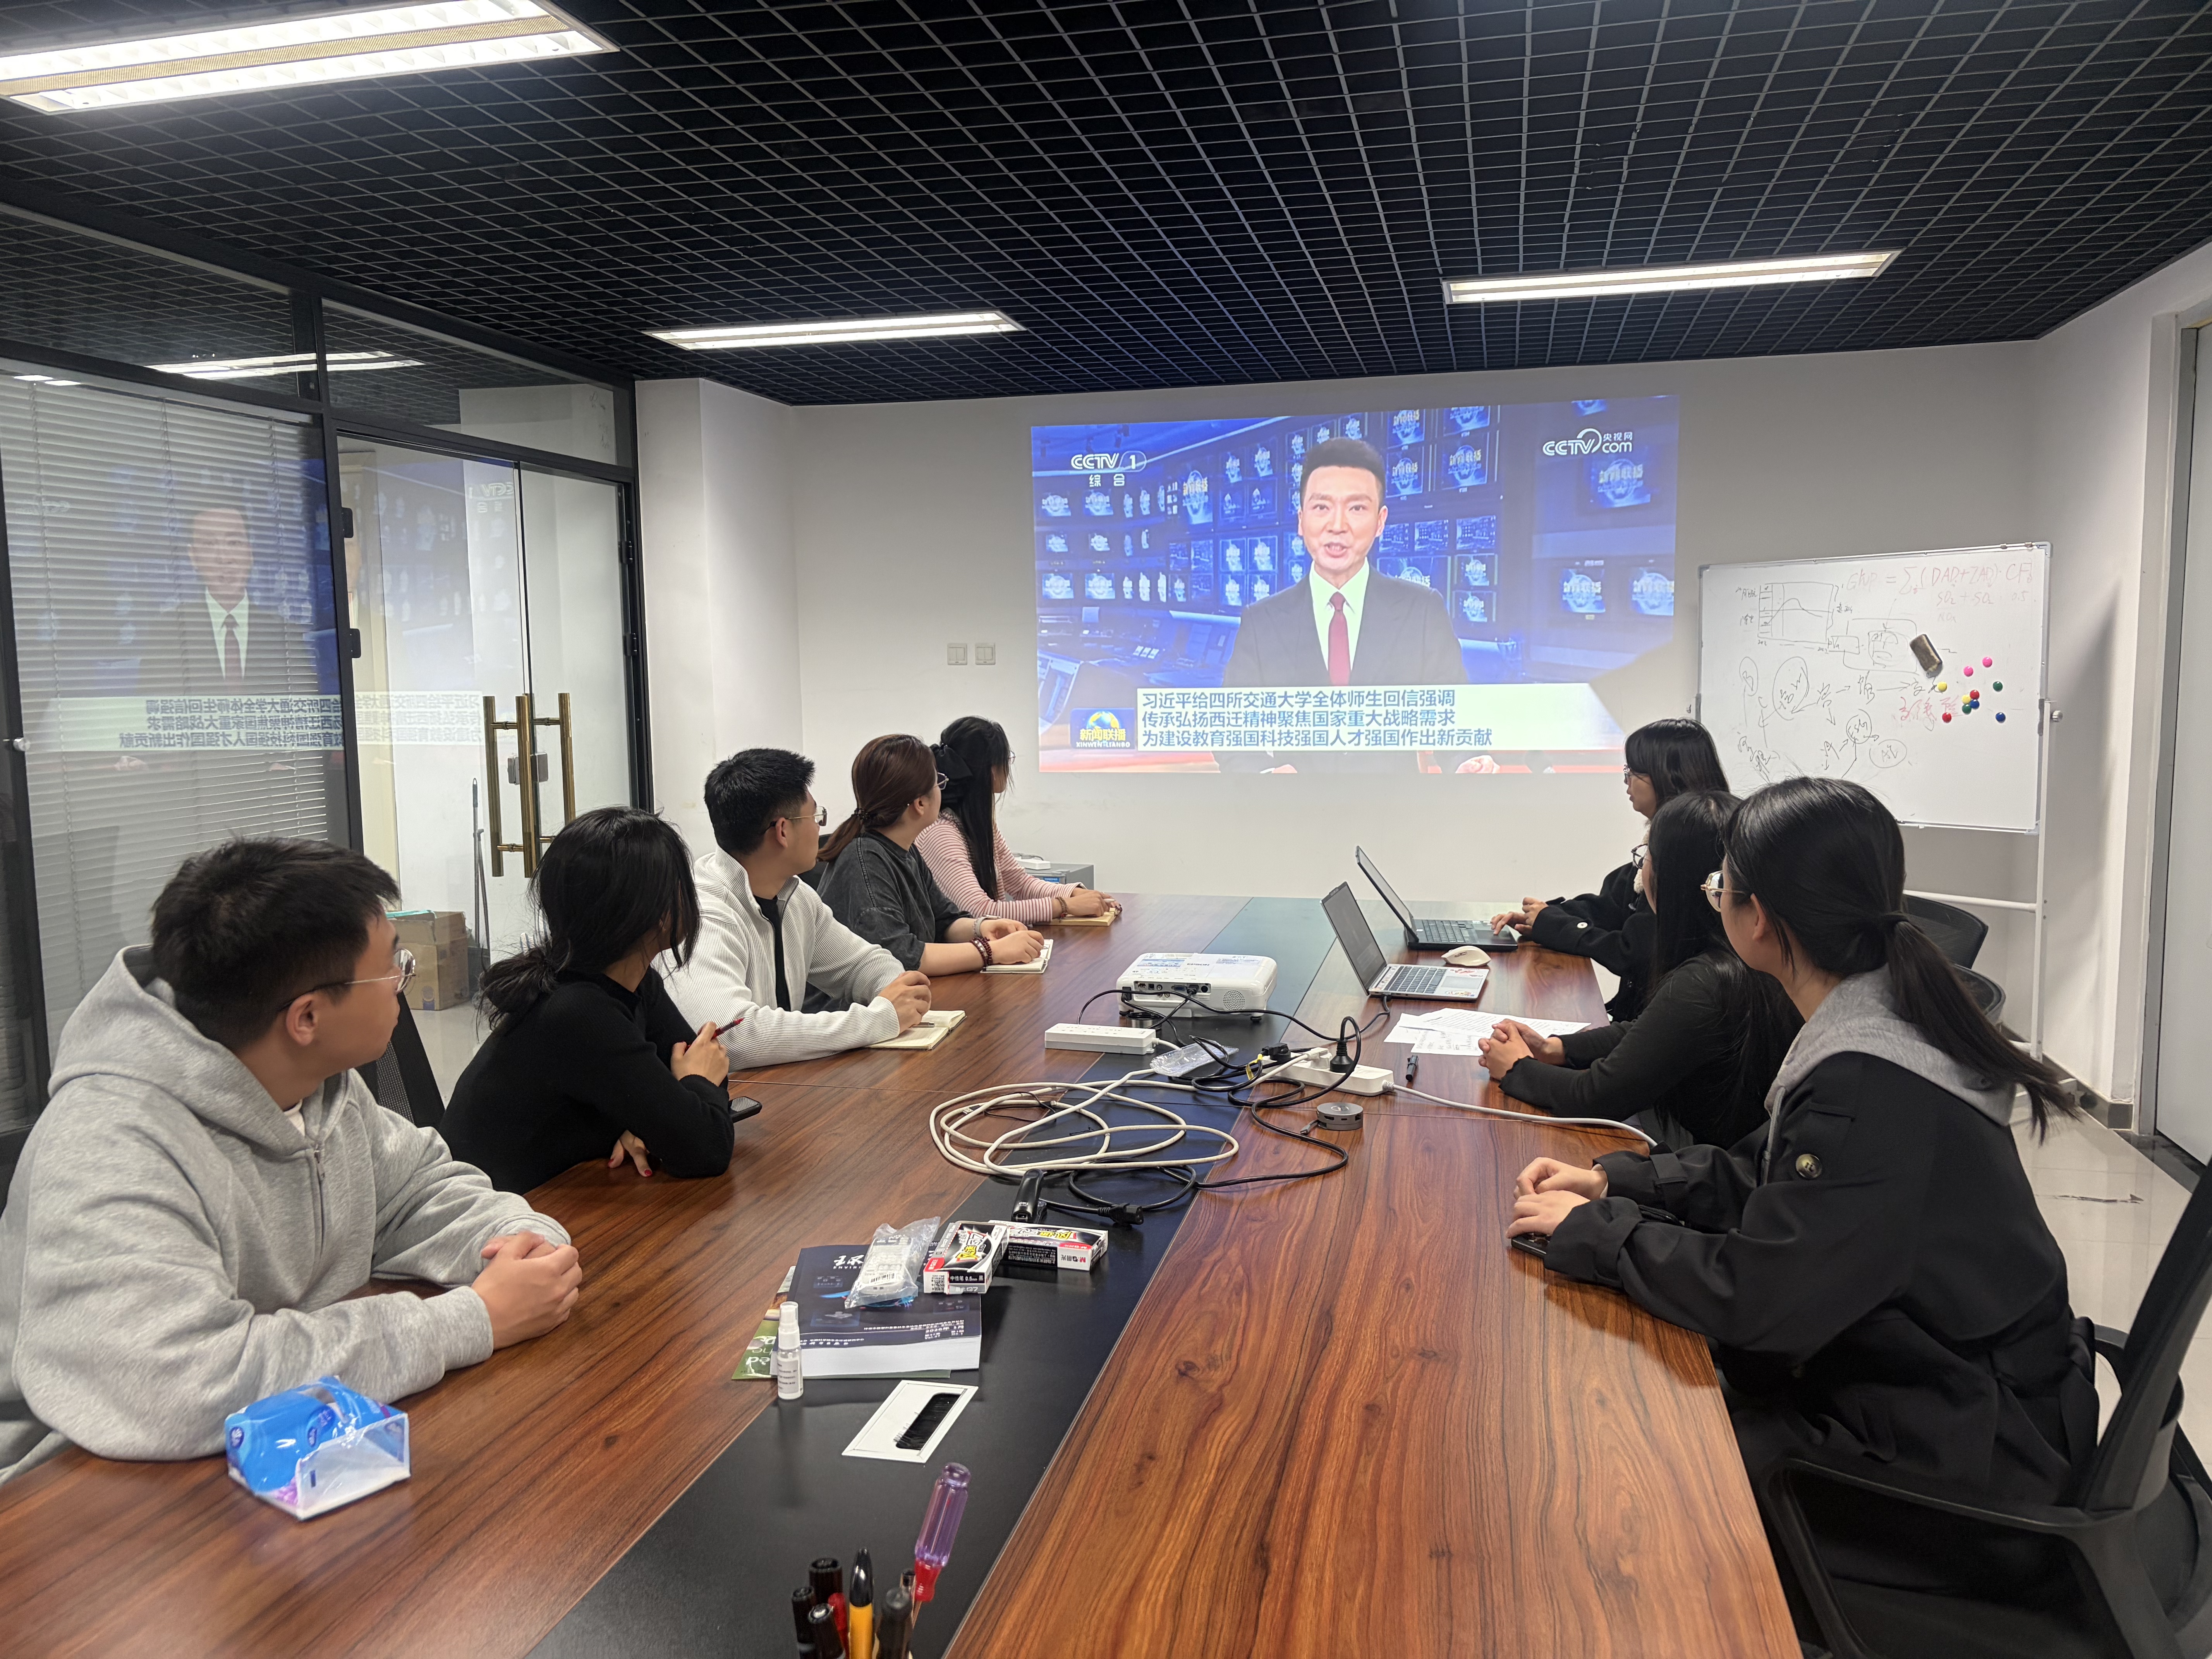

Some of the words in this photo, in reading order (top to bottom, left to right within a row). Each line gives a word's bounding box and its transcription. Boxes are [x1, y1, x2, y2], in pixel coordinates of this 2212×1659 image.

[1603, 431, 1633, 441] 央视网
[1542, 438, 1595, 456] CCTV
[1602, 442, 1632, 453] com
[1071, 453, 1120, 469] CCTV
[1130, 455, 1136, 469] 1
[1089, 473, 1125, 487] 综合
[1142, 690, 1455, 709] 习近平给四所交通大学全体师生回信强调
[1142, 709, 1455, 728] 传承弘扬西迁精神聚焦国家重大战略需求
[1080, 728, 1126, 741] 新闻联播
[1142, 728, 1492, 748] 为建设教育强国科技强国人才强国作出新贡献
